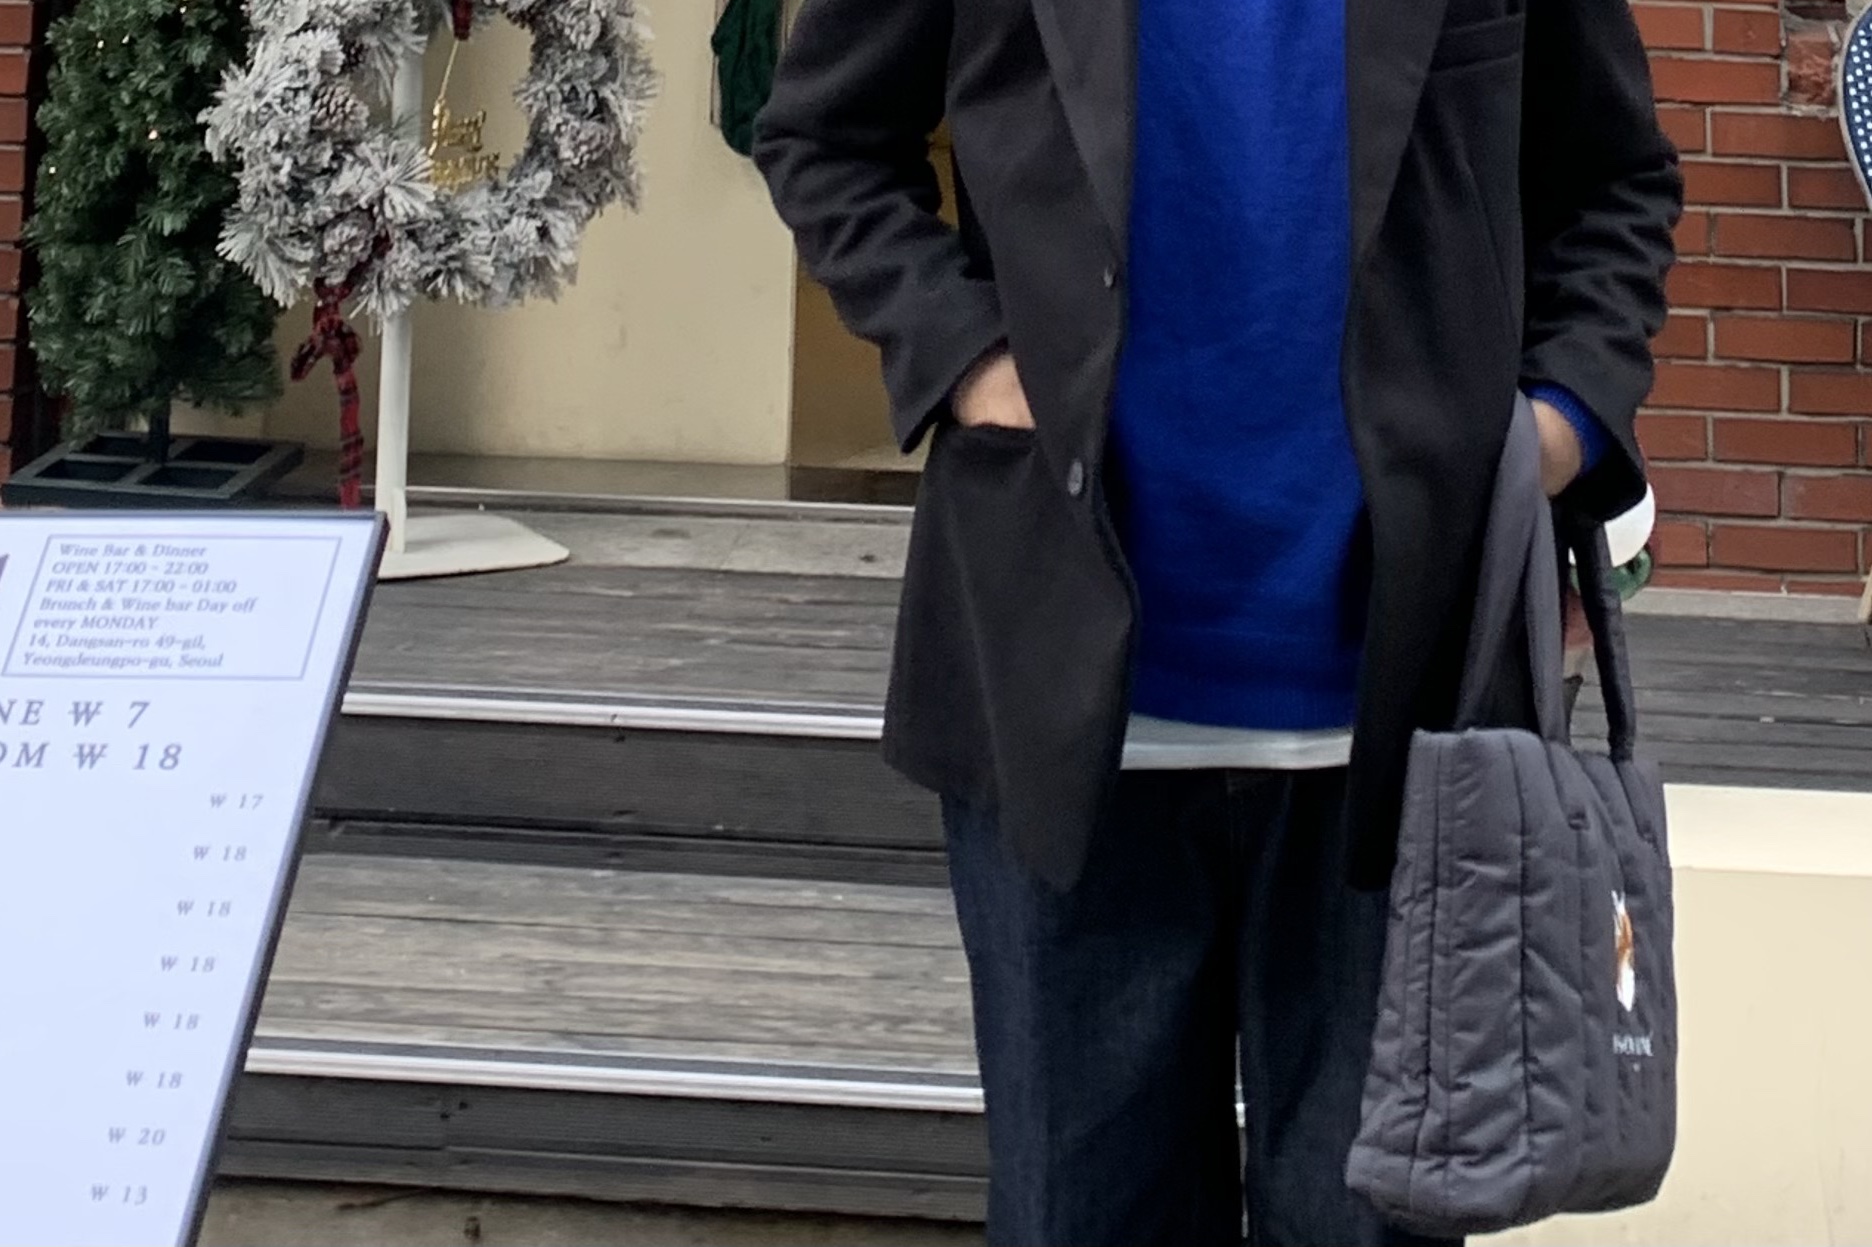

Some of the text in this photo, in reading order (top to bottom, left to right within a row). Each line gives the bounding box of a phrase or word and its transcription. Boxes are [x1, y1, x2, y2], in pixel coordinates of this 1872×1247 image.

[59, 543, 207, 557] Wine Bar & Dinner
[52, 561, 99, 574] OPEN
[103, 562, 147, 575] 17:00
[163, 562, 209, 575] 22:00
[45, 579, 74, 593] FRI
[76, 580, 89, 593] &
[94, 579, 127, 593] SAT
[131, 580, 175, 593] 17:00
[191, 580, 237, 593] 01:00
[39, 597, 258, 614] Brunch & Wine bar Day off
[33, 616, 159, 630] every MONDAY
[29, 634, 50, 648] 14,
[55, 635, 150, 650] Dangsan-ro
[178, 653, 224, 667] Seoul
[127, 702, 150, 728] 7
[132, 743, 182, 770] 18
